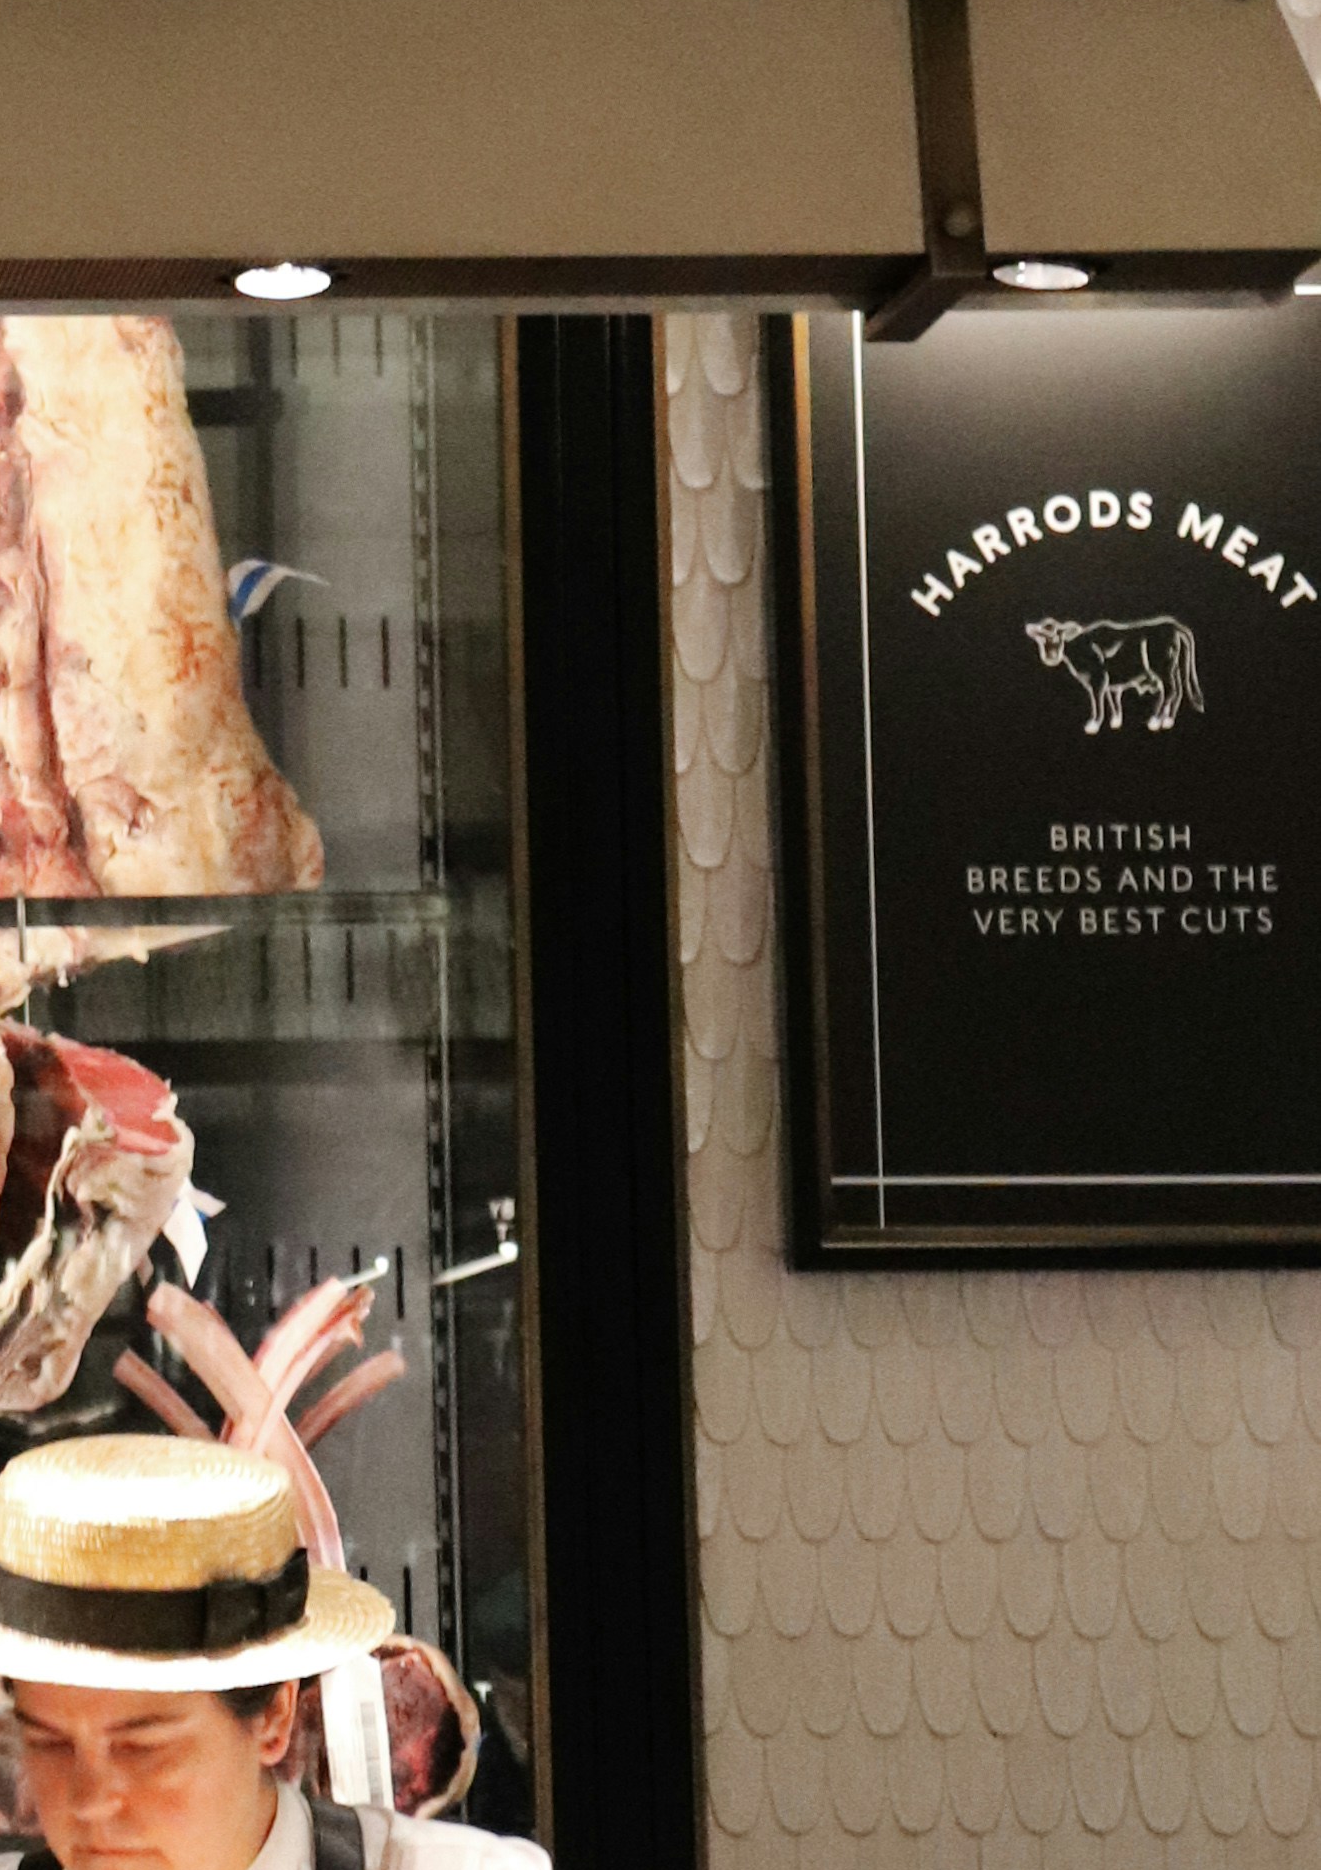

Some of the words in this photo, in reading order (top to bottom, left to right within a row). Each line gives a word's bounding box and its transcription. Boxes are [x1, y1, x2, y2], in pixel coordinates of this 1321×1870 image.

[909, 489, 1155, 617] HARRODS
[1176, 501, 1319, 610] MEAT
[1049, 824, 1192, 852] BRITISH
[966, 865, 1102, 894] BREEDS
[1116, 865, 1194, 893] AND
[1207, 864, 1279, 893] THE
[973, 907, 1065, 935] VERY
[1079, 907, 1166, 935] BEST
[1180, 906, 1274, 935] CUTS
